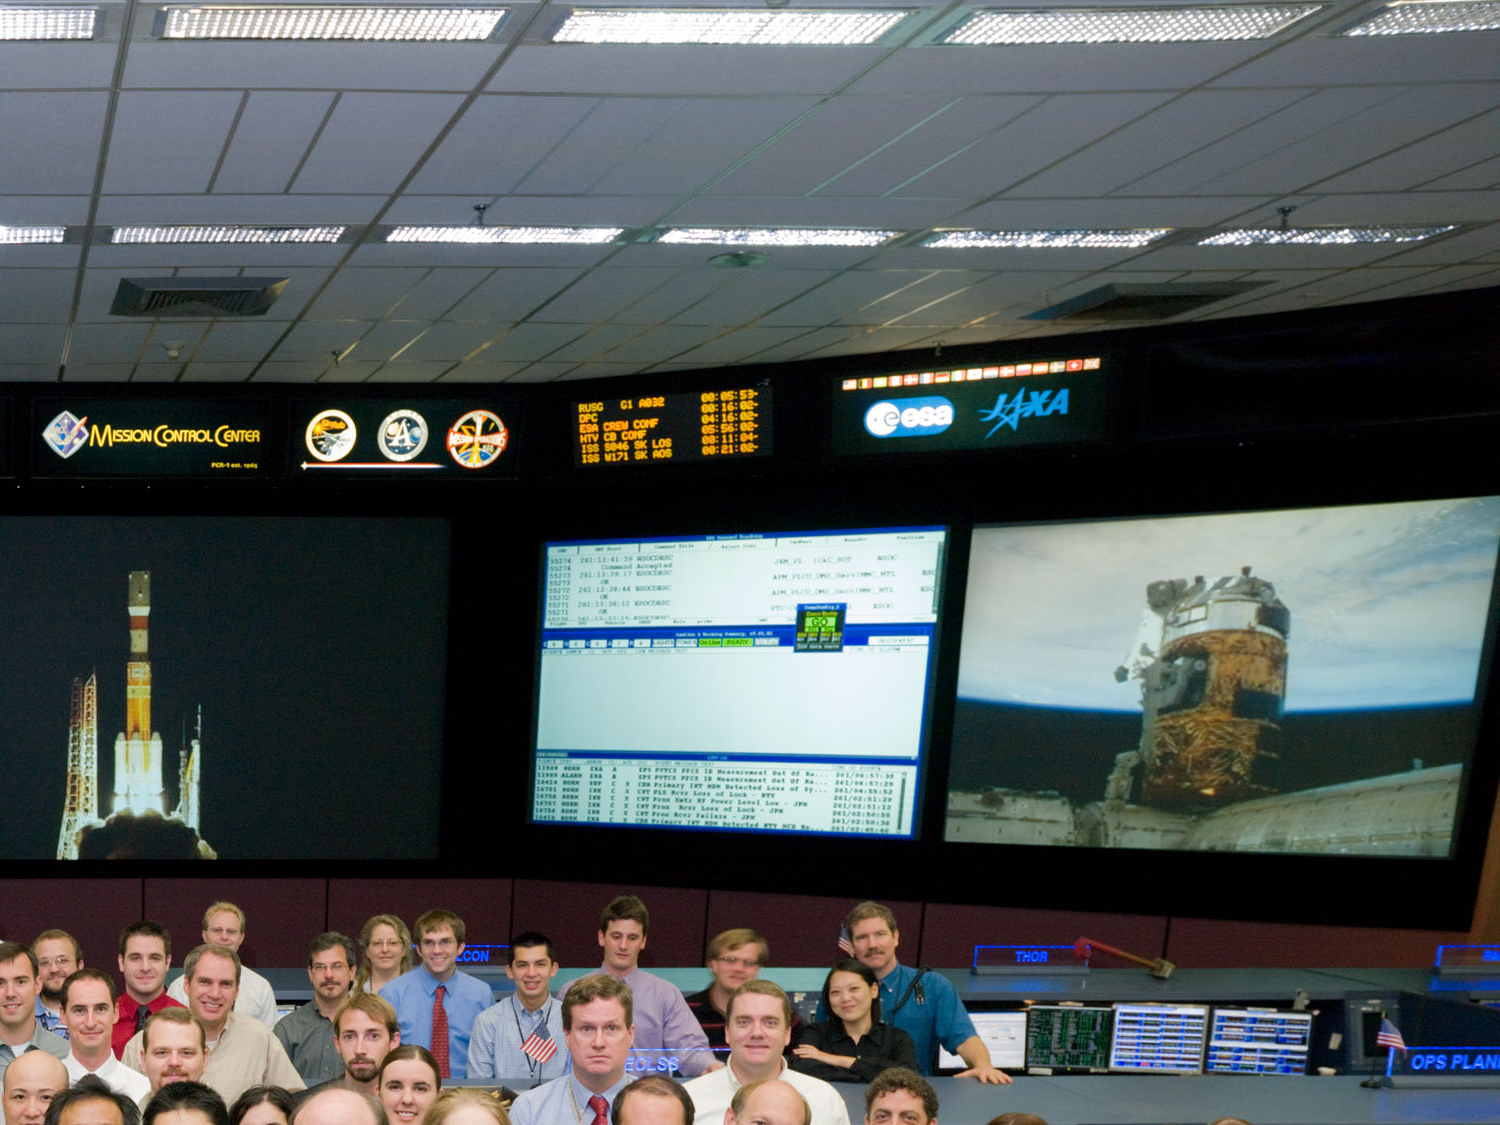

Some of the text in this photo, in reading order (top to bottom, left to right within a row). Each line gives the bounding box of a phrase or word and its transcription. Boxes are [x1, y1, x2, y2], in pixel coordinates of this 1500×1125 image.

[579, 413, 598, 423] DPC
[901, 405, 953, 428] esa
[977, 386, 1070, 440] JAXA
[579, 424, 599, 433] ESA
[603, 421, 629, 432] CREW
[633, 418, 659, 429] CONF
[580, 434, 599, 443] HTV
[621, 430, 647, 440] CONF
[581, 444, 600, 453] ISS
[634, 440, 647, 450] SK
[652, 438, 672, 448] LOS
[582, 454, 600, 464] ISS
[634, 450, 648, 460] SK
[653, 449, 672, 459] AOS
[812, 618, 828, 626] GO
[1015, 950, 1049, 963] THOR
[625, 1056, 679, 1072] ECLSS
[1410, 1054, 1447, 1070] OPS
